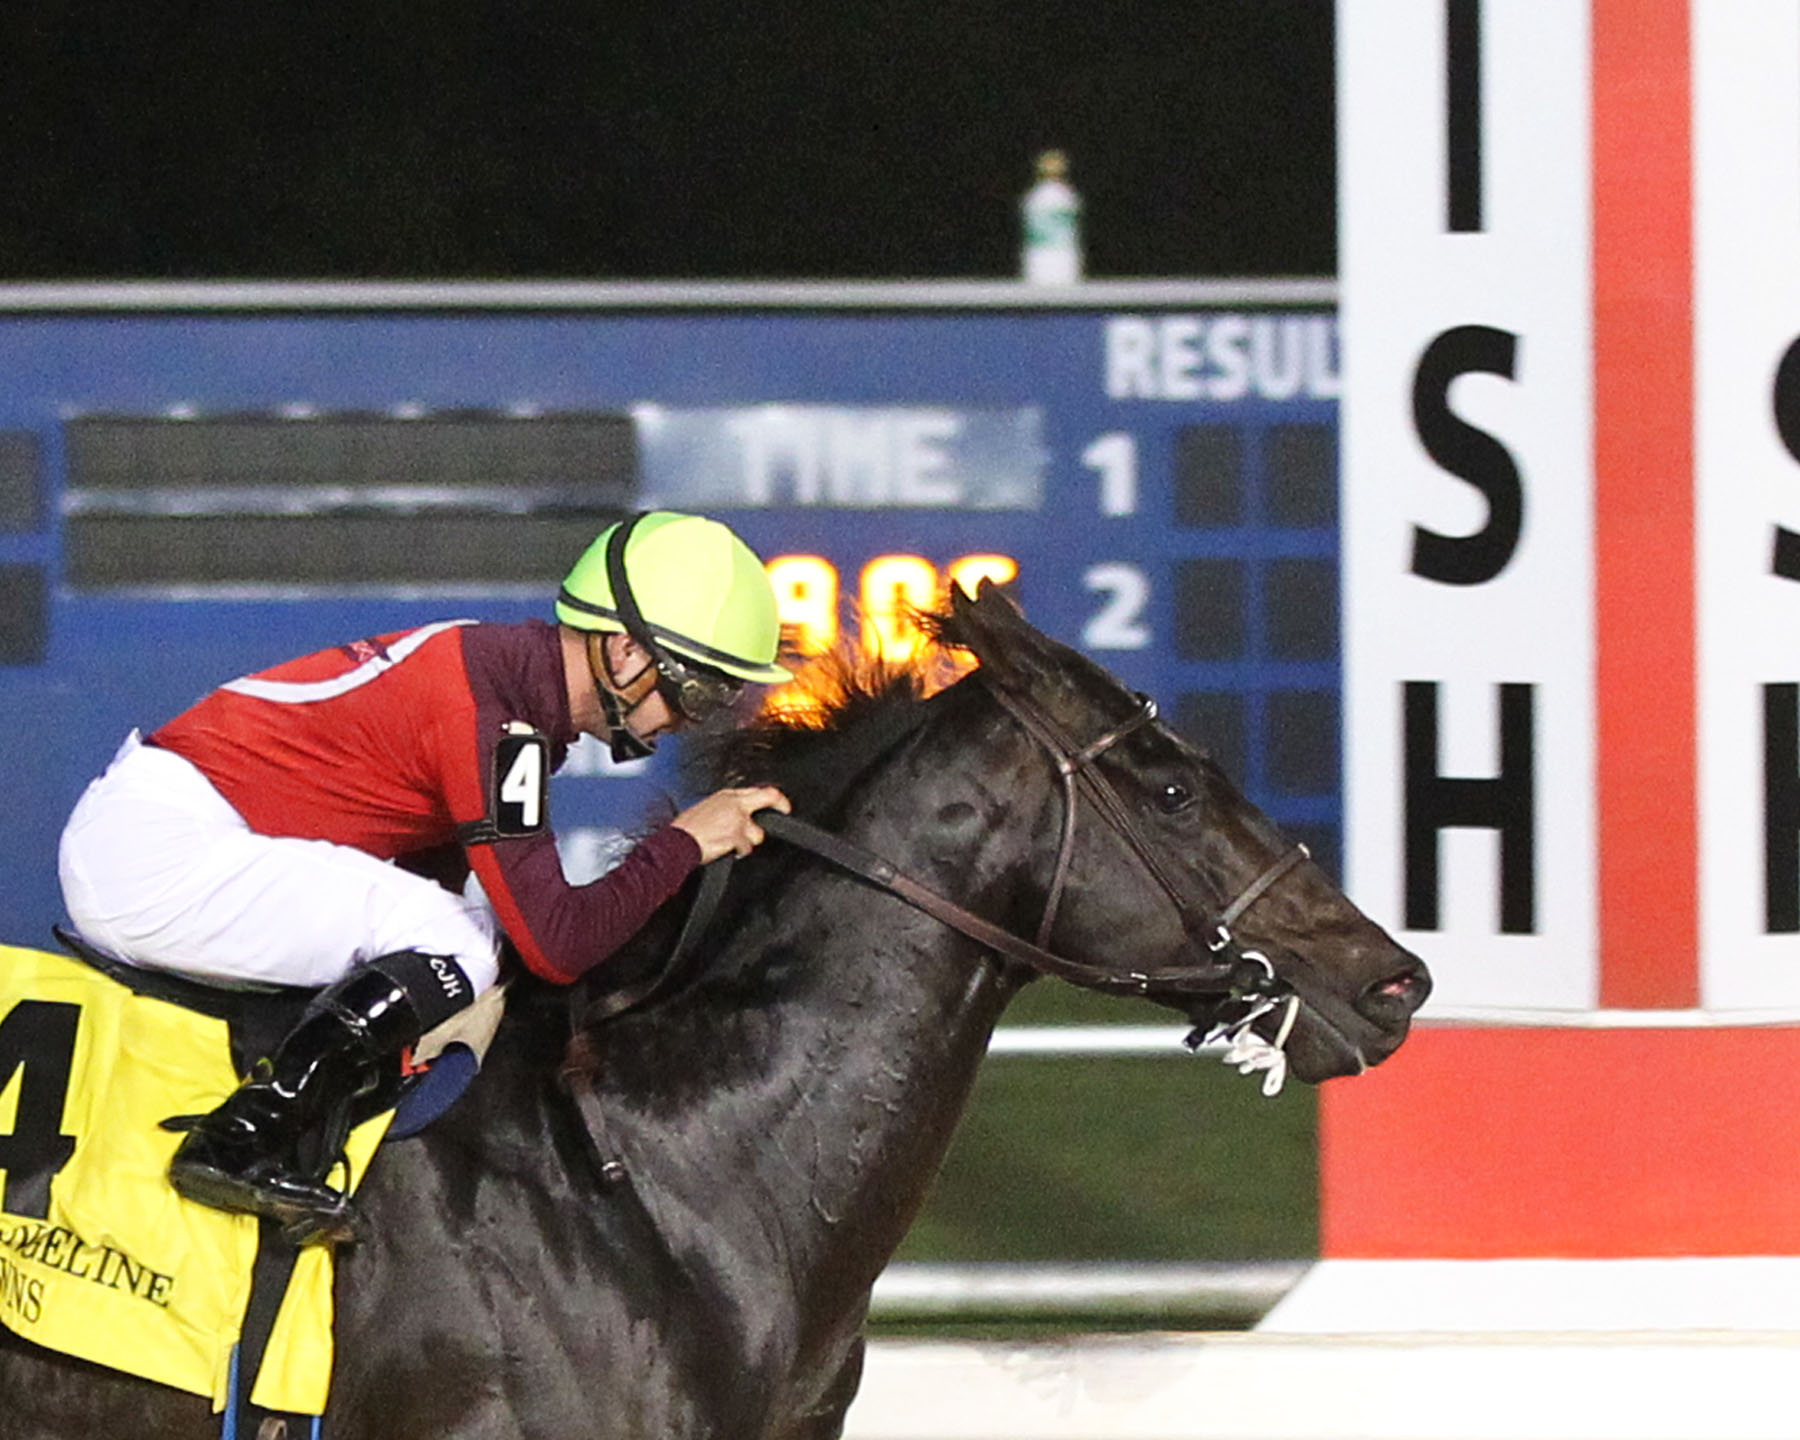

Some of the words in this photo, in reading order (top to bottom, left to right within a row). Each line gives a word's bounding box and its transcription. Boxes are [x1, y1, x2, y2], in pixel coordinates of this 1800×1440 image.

[724, 408, 960, 506] TIME
[1082, 431, 1138, 517] 1
[1081, 562, 1153, 650] 2
[500, 742, 541, 827] 4
